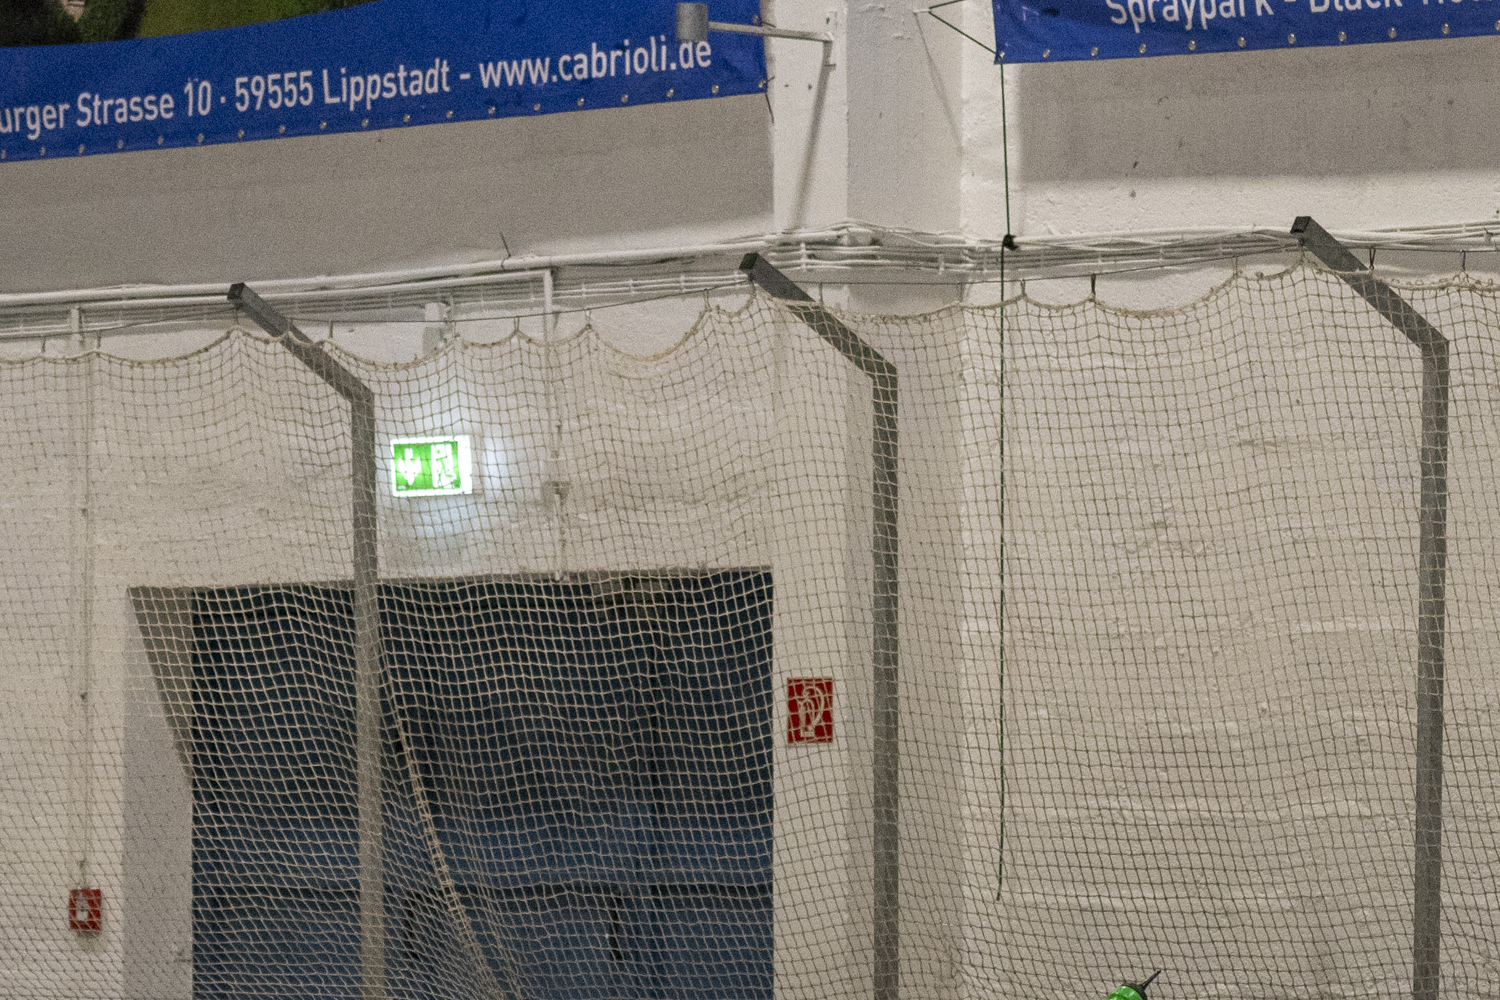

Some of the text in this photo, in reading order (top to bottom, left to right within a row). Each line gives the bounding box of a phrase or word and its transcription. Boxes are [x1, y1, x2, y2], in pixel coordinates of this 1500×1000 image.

[76, 91, 175, 127] Strasse
[184, 79, 212, 117] 10
[235, 70, 314, 112] 59555
[321, 58, 452, 111] Lippstadt
[478, 34, 713, 89] www.cabrioli.de
